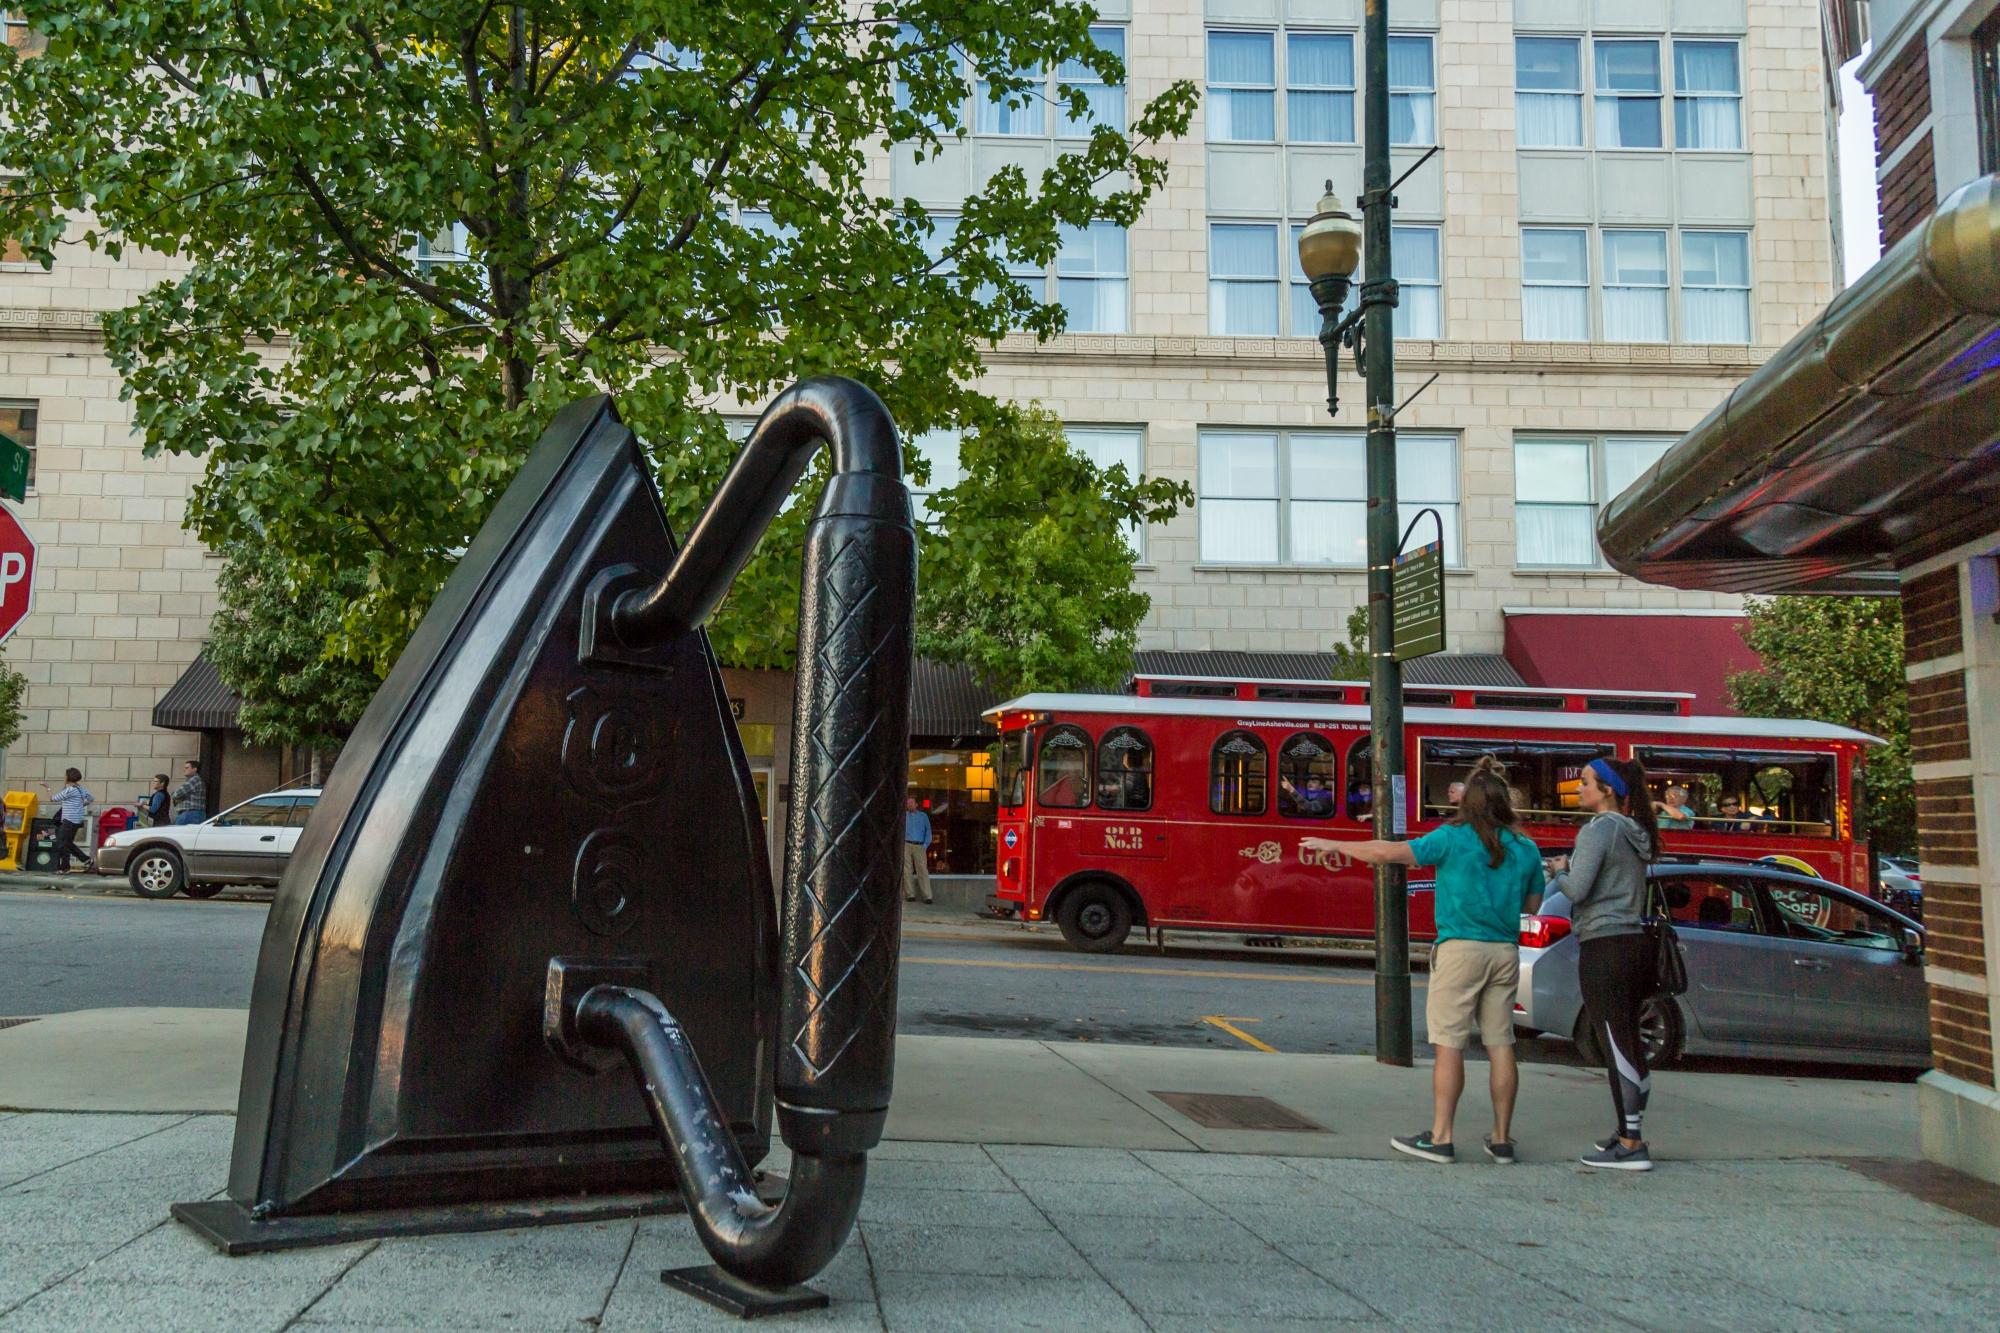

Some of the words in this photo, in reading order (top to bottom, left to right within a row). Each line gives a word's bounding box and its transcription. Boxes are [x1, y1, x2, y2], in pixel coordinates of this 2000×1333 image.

[13, 452, 24, 476] St
[1237, 719, 1310, 728] GrayLineAsheville.com
[1105, 826, 1142, 835] OLD
[1104, 834, 1143, 849] No.8
